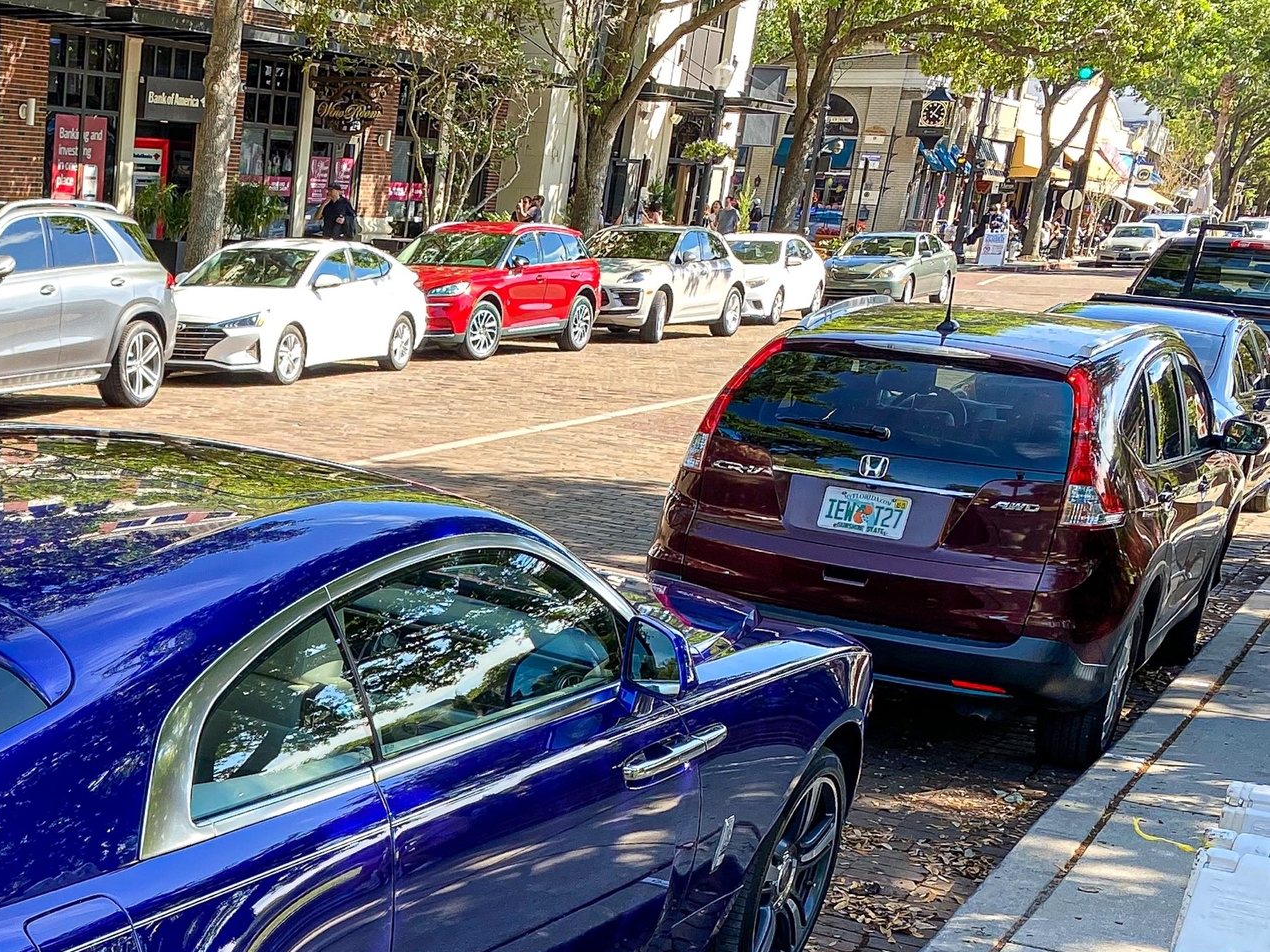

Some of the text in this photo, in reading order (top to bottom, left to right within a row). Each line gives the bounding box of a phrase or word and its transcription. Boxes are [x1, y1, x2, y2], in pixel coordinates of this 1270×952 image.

[148, 91, 167, 105] Bank
[174, 93, 199, 108] America
[59, 127, 103, 143] Banking and
[65, 162, 78, 171] one
[56, 174, 74, 189] place
[825, 498, 904, 530] IEW T27
[990, 501, 1041, 513] AWD
